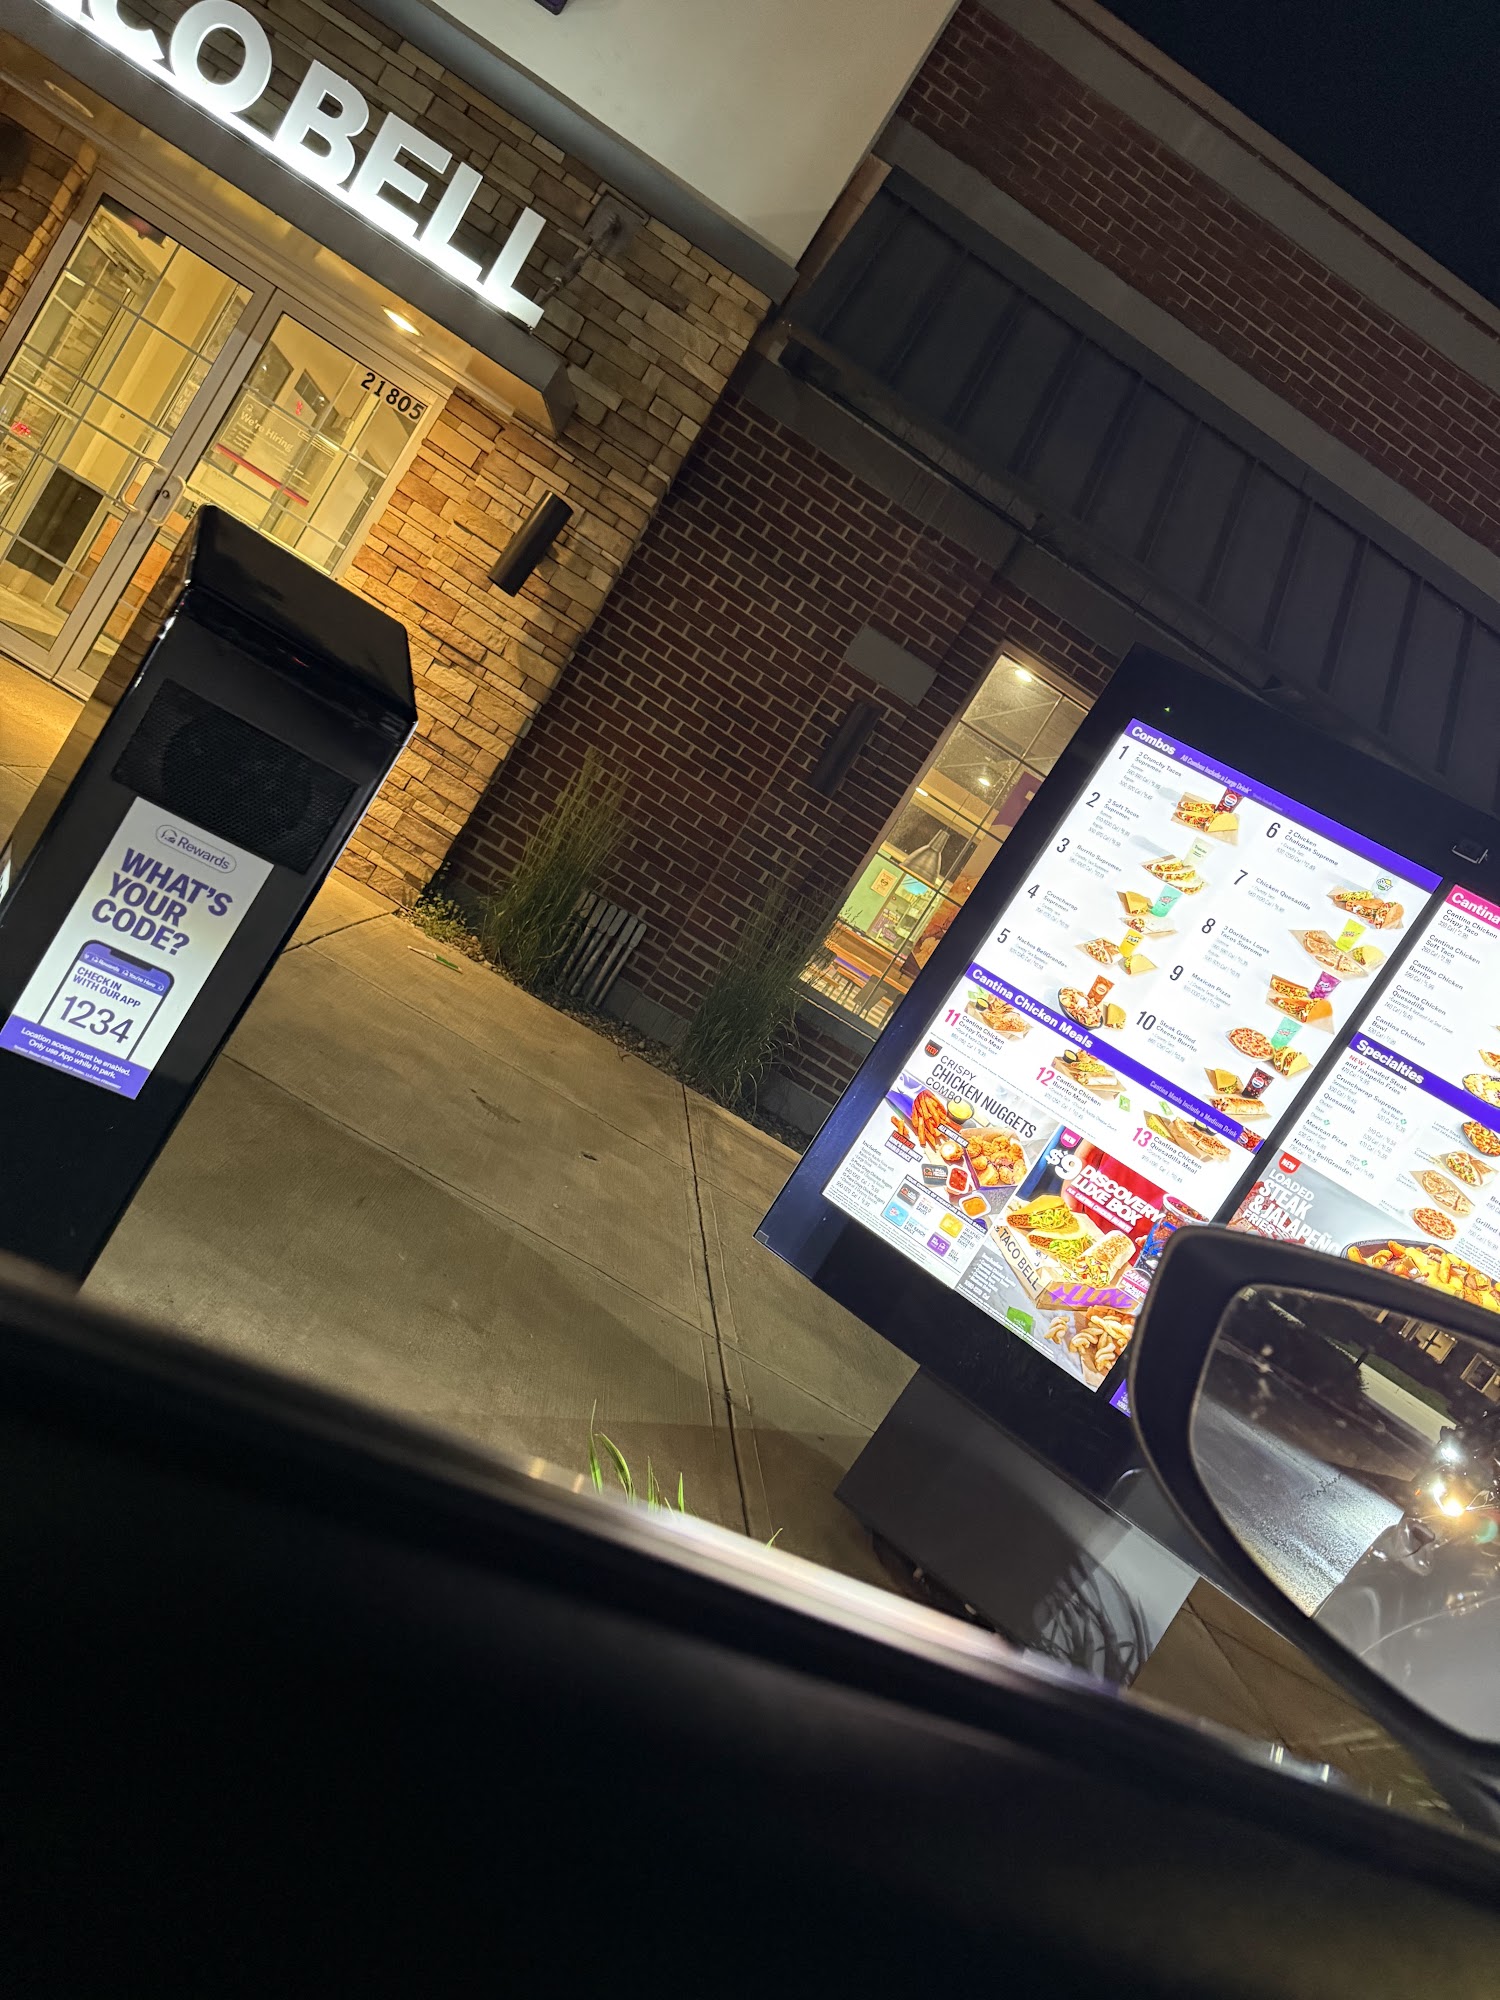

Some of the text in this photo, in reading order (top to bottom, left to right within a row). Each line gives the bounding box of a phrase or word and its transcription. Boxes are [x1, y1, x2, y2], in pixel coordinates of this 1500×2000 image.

[272, 59, 546, 329] BELL
[360, 371, 430, 422] 21805
[240, 411, 266, 433] We're
[265, 428, 294, 453] Hiring
[1118, 745, 1130, 760] 1
[1132, 726, 1176, 755] Combos
[1142, 754, 1166, 769] Crunchy
[1166, 765, 1182, 777] Tacos
[1180, 754, 1188, 762] All
[1186, 757, 1206, 771] Combos
[1204, 766, 1222, 780] Include
[1224, 776, 1237, 788] Large
[1086, 792, 1101, 808] 2
[1112, 800, 1124, 810] Soft
[1124, 807, 1139, 818] Tacos
[1266, 822, 1281, 838] 6
[1293, 832, 1317, 847] Chicken
[177, 836, 230, 870] Rewards
[1056, 837, 1070, 853] 3
[1076, 844, 1096, 858] Burrito
[1284, 834, 1312, 852] Chalupas
[1312, 849, 1338, 866] Supreme
[121, 847, 233, 916] WHAT'S
[1234, 869, 1248, 885] 7
[108, 871, 188, 927] YOUR
[1027, 884, 1040, 899] 4
[1046, 890, 1078, 911] Crunchwrap
[1256, 878, 1280, 893] Chicken
[1280, 890, 1311, 910] Quesadilla
[1452, 892, 1500, 925] Cantina
[92, 898, 190, 956] CODE?
[997, 928, 1011, 944] 5
[1201, 918, 1216, 934] 8
[1442, 914, 1463, 929] Crispy
[1464, 925, 1479, 936] Taco
[1446, 909, 1471, 925] Cantina
[1472, 922, 1498, 939] Chicken
[1017, 935, 1036, 950] Nachos
[1220, 930, 1262, 957] Tacos Supreme
[1252, 941, 1270, 954] Locos
[1425, 940, 1440, 950] Soft
[1440, 947, 1455, 958] Taco
[1429, 934, 1454, 950] Cantina
[1454, 948, 1480, 964] Chicken
[77, 966, 122, 991] CHECK IN
[98, 959, 120, 972] Rewards
[1170, 965, 1184, 981] 9
[1408, 965, 1431, 980] Burrito
[1412, 959, 1437, 976] Cantina
[1438, 973, 1464, 990] Chicken
[73, 974, 141, 1008] WITH OUR APP
[1192, 972, 1216, 989] Mexican
[1215, 986, 1231, 998] Pizza
[972, 969, 1093, 1048] Cantina Chicken Meals
[1392, 990, 1425, 1011] Quesadilla
[1396, 984, 1446, 1016] Cantina Chicken
[60, 996, 134, 1044] 1234
[944, 1009, 961, 1027] 11
[962, 1015, 983, 1031] Cantina
[982, 1028, 1005, 1045] Chicken
[1136, 1011, 1156, 1030] 10
[1371, 1020, 1388, 1032] Bowl
[1375, 1015, 1400, 1032] Cantina
[1400, 1029, 1426, 1046] Chicken
[958, 1020, 1002, 1050] Crispy Taco Meal
[1156, 1025, 1177, 1040] Cheese
[1177, 1037, 1197, 1052] Burrito
[1160, 1020, 1196, 1044] Steak Grilled
[20, 1027, 52, 1044] Location
[50, 1040, 76, 1054] access
[75, 1050, 94, 1061] must
[93, 1056, 103, 1065] be
[102, 1061, 130, 1076] enabled.
[28, 1039, 46, 1051] Only
[45, 1047, 59, 1056] use
[58, 1052, 74, 1062] App
[74, 1058, 92, 1069] while
[92, 1064, 100, 1072] in
[98, 1068, 116, 1079] park.
[1356, 1040, 1424, 1088] Specialties
[940, 1055, 976, 1081] CRISPY
[1036, 1067, 1055, 1086] 12
[1345, 1061, 1358, 1070] and
[1358, 1068, 1384, 1086] Jalapeño
[1385, 1083, 1400, 1095] Fries
[1366, 1064, 1390, 1081] Loaded
[1389, 1078, 1407, 1092] Steak
[925, 1075, 963, 1105] COMBO
[1052, 1080, 1088, 1105] Burrito Meal
[1056, 1075, 1101, 1106] Cantina Chicken
[1336, 1074, 1373, 1098] Crunchwrap
[932, 1064, 984, 1104] CHICKEN
[980, 1096, 1037, 1138] NUGGETS
[1150, 1080, 1237, 1138] Cantina Meals Include Medium Drink
[1323, 1092, 1356, 1114] Quesadilla
[1132, 1127, 1152, 1147] 13
[1293, 1138, 1315, 1154] Nachos
[1306, 1119, 1331, 1137] Mexican
[1331, 1134, 1348, 1147] Pizza
[1150, 1142, 1181, 1164] Quesadilla
[1182, 1162, 1198, 1174] Meal
[1154, 1136, 1177, 1154] Cantina
[1177, 1151, 1202, 1170] Chicken
[1281, 1158, 1296, 1171] NEW
[1046, 1143, 1084, 1181] $9
[1080, 1163, 1166, 1223] DISCOVERY
[1268, 1168, 1315, 1201] LOADED
[1075, 1174, 1141, 1226] LUXE BOX
[1258, 1179, 1313, 1220] STEAK
[1242, 1208, 1276, 1235] FRIES
[1475, 1217, 1498, 1234] Grilled
[999, 1227, 1039, 1292] TACO BELL
